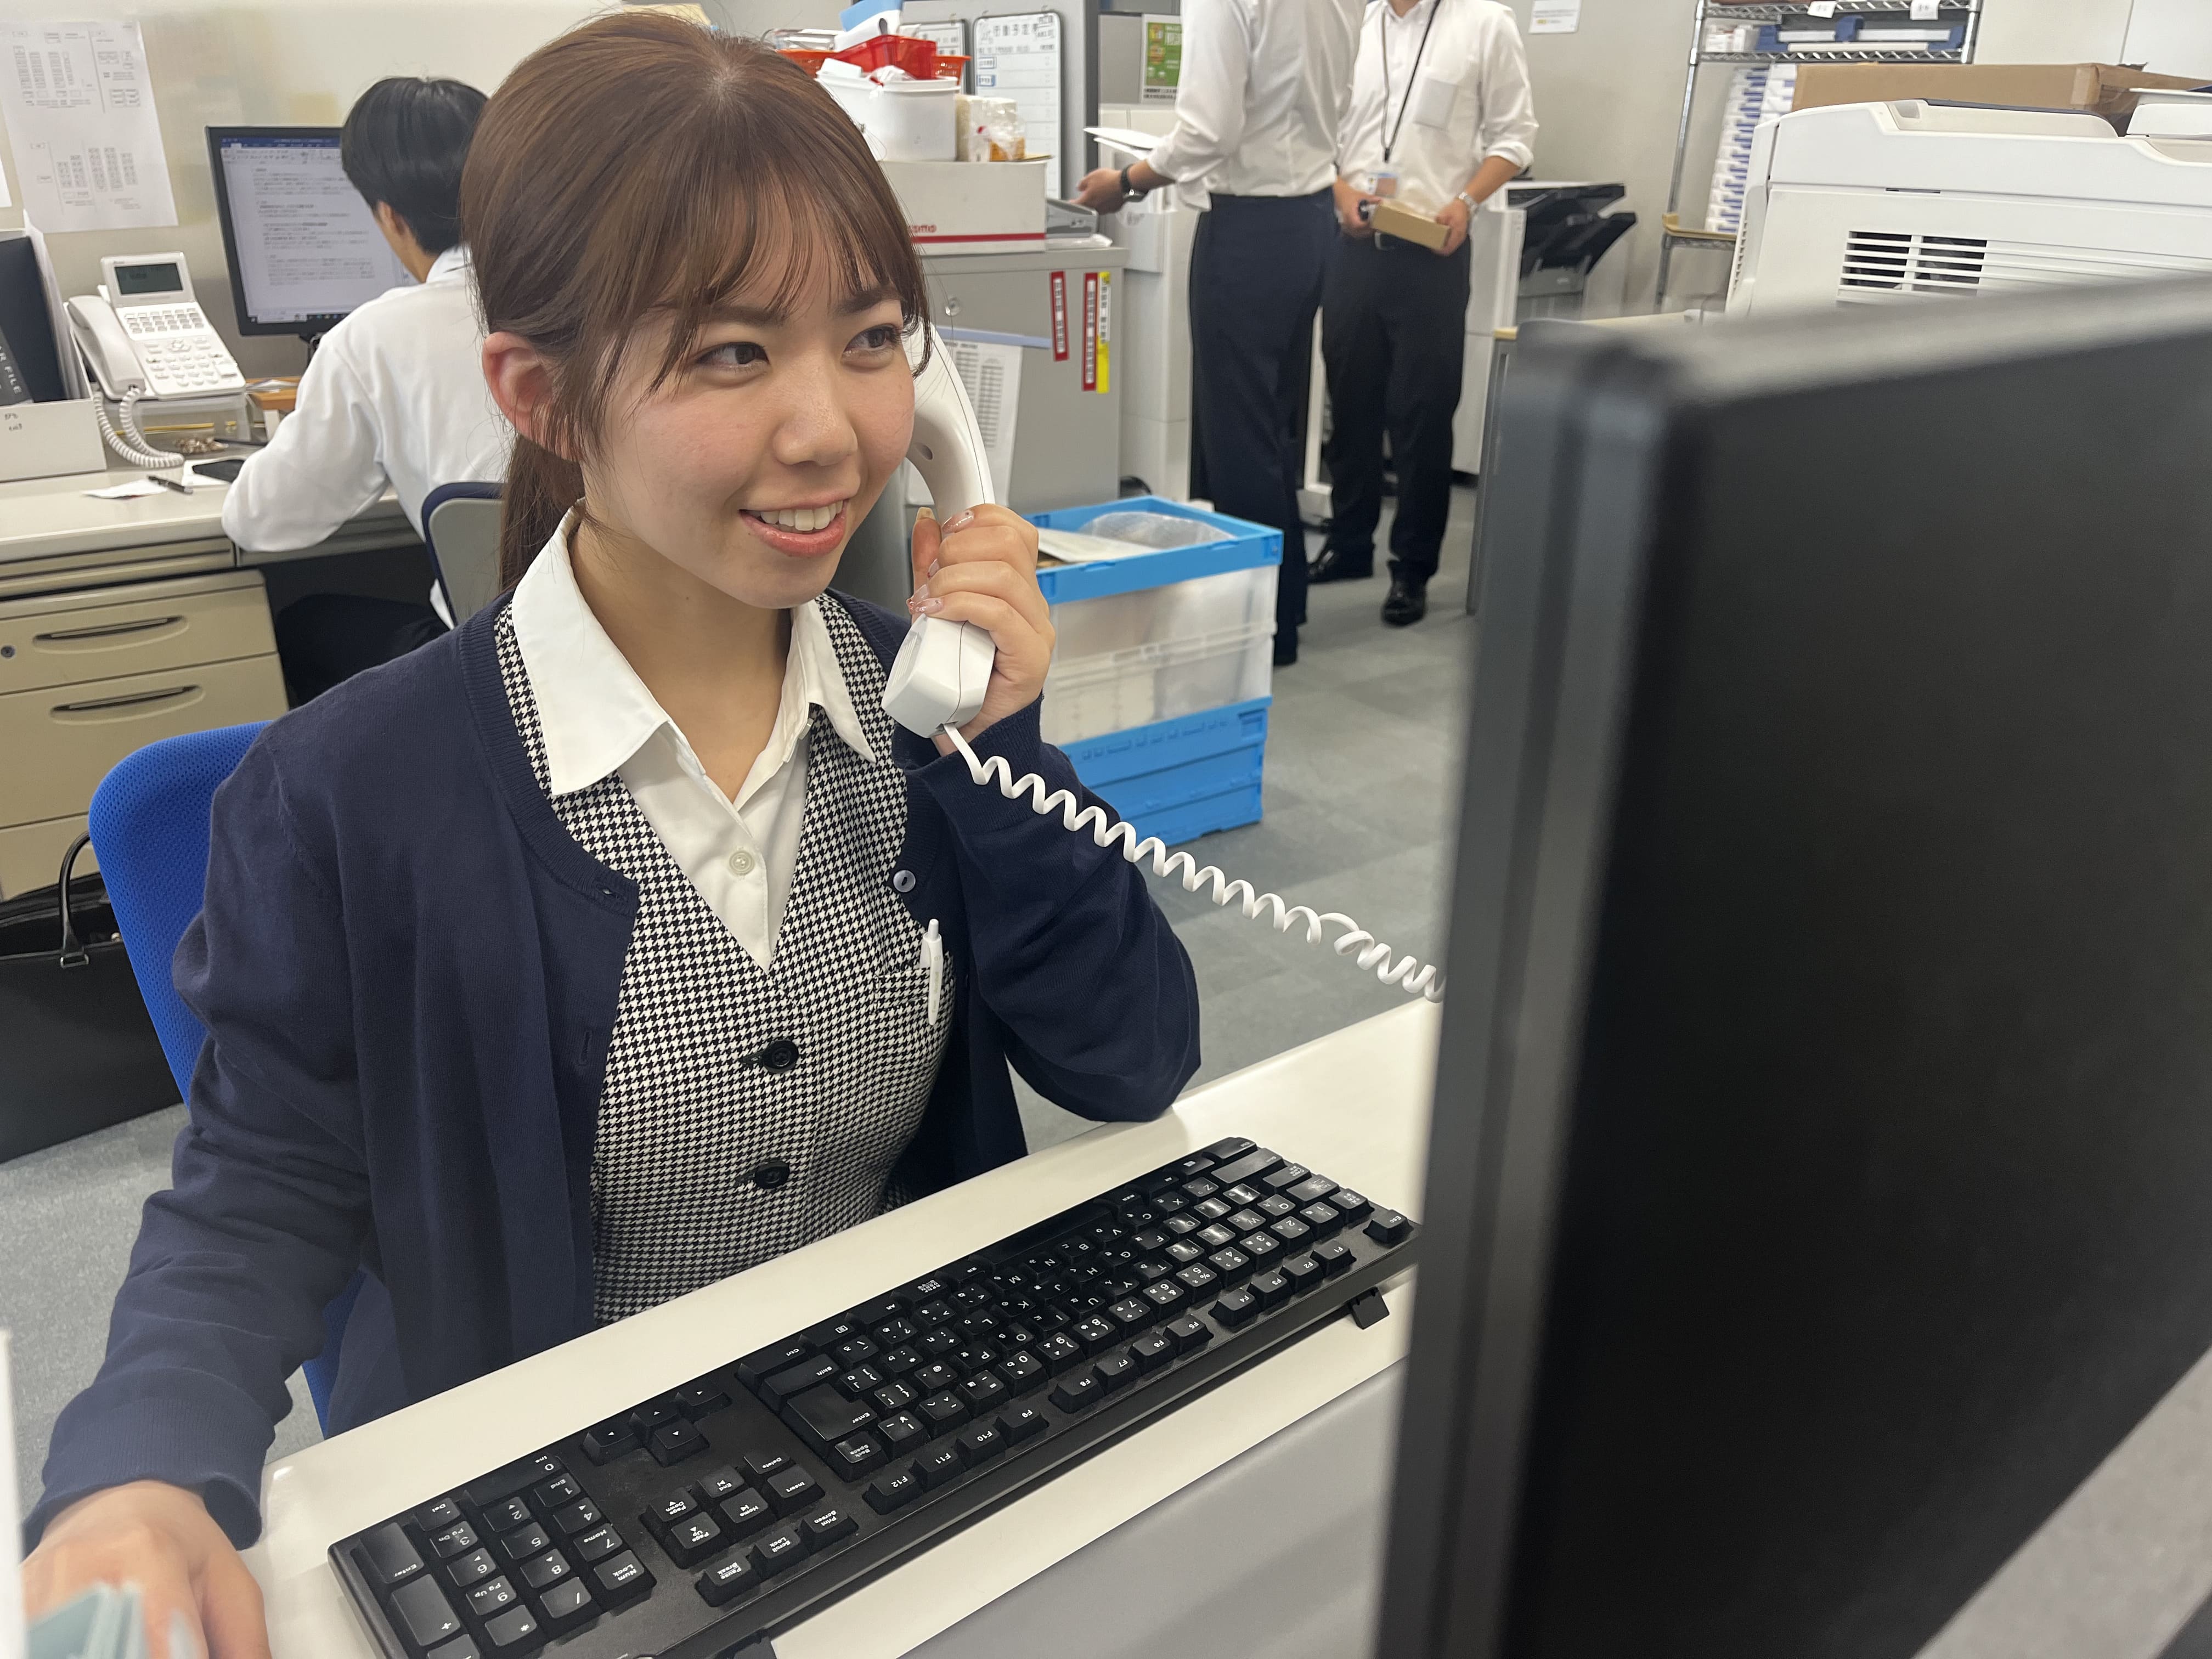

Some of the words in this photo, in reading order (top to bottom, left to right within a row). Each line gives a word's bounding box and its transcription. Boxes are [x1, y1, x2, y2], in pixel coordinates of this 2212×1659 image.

[4, 365, 22, 394] FILE
[816, 1367, 832, 1375] Shift
[853, 1413, 870, 1423] Enter
[978, 1431, 992, 1441] F10
[850, 1444, 869, 1455] Space
[855, 1448, 870, 1457] Back
[763, 1458, 781, 1468] Delete
[936, 1453, 951, 1464] F11
[550, 1479, 566, 1489] End
[719, 1482, 732, 1491] End
[891, 1476, 907, 1487] F12
[786, 1482, 805, 1492] Insert
[432, 1504, 445, 1512] Del
[665, 1502, 685, 1512] Down
[670, 1505, 686, 1515] Page
[740, 1505, 759, 1516] Home
[512, 1510, 522, 1519] 2
[814, 1510, 837, 1523] Screen
[821, 1516, 837, 1526] Print
[460, 1537, 469, 1545] 3
[584, 1530, 607, 1543] Home
[692, 1531, 709, 1542] Page
[532, 1538, 541, 1547] 5
[606, 1539, 614, 1548] 7
[769, 1537, 787, 1548] Lock
[772, 1541, 791, 1552] Scroll
[394, 1564, 416, 1577] Enter
[478, 1565, 487, 1573] 6
[552, 1565, 561, 1574] 8
[613, 1564, 634, 1577] Lock
[718, 1562, 737, 1575] Break
[721, 1566, 742, 1579] Pause
[618, 1569, 637, 1581] Num
[498, 1592, 507, 1601] 9
